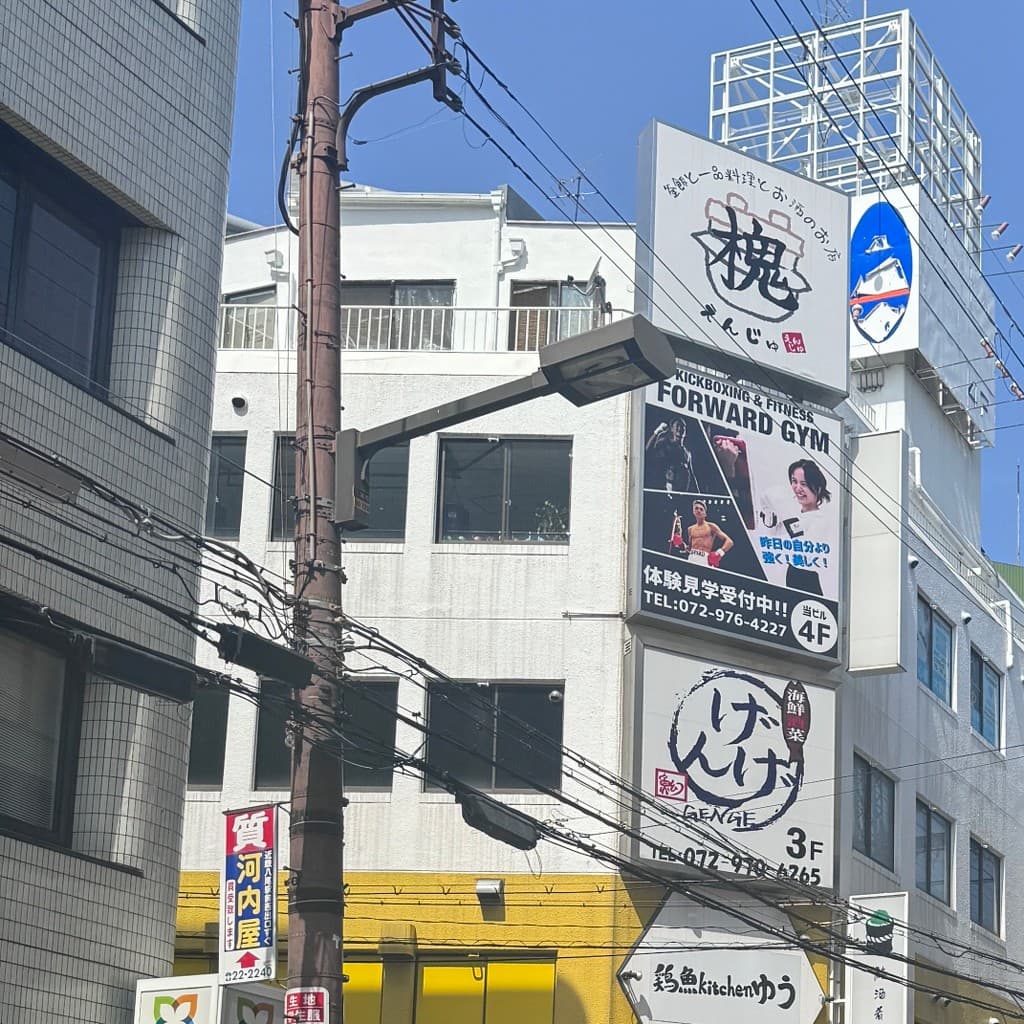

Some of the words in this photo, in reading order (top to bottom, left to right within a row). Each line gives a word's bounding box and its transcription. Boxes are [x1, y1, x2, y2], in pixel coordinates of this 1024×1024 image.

[675, 368, 750, 404] KICKBOXING
[752, 394, 763, 407] &
[765, 398, 814, 424] FITNESS
[656, 380, 773, 436] FORWARD
[780, 419, 830, 455] GYM
[759, 536, 831, 554] 昨日の自分より
[643, 590, 788, 637] TEL:072-976-4227
[802, 604, 827, 621] 当ビル
[798, 619, 831, 646] 4F
[232, 810, 269, 853] 質
[683, 804, 757, 827] GENGE
[235, 851, 263, 950] 河内屋
[287, 993, 318, 1008] 生地
